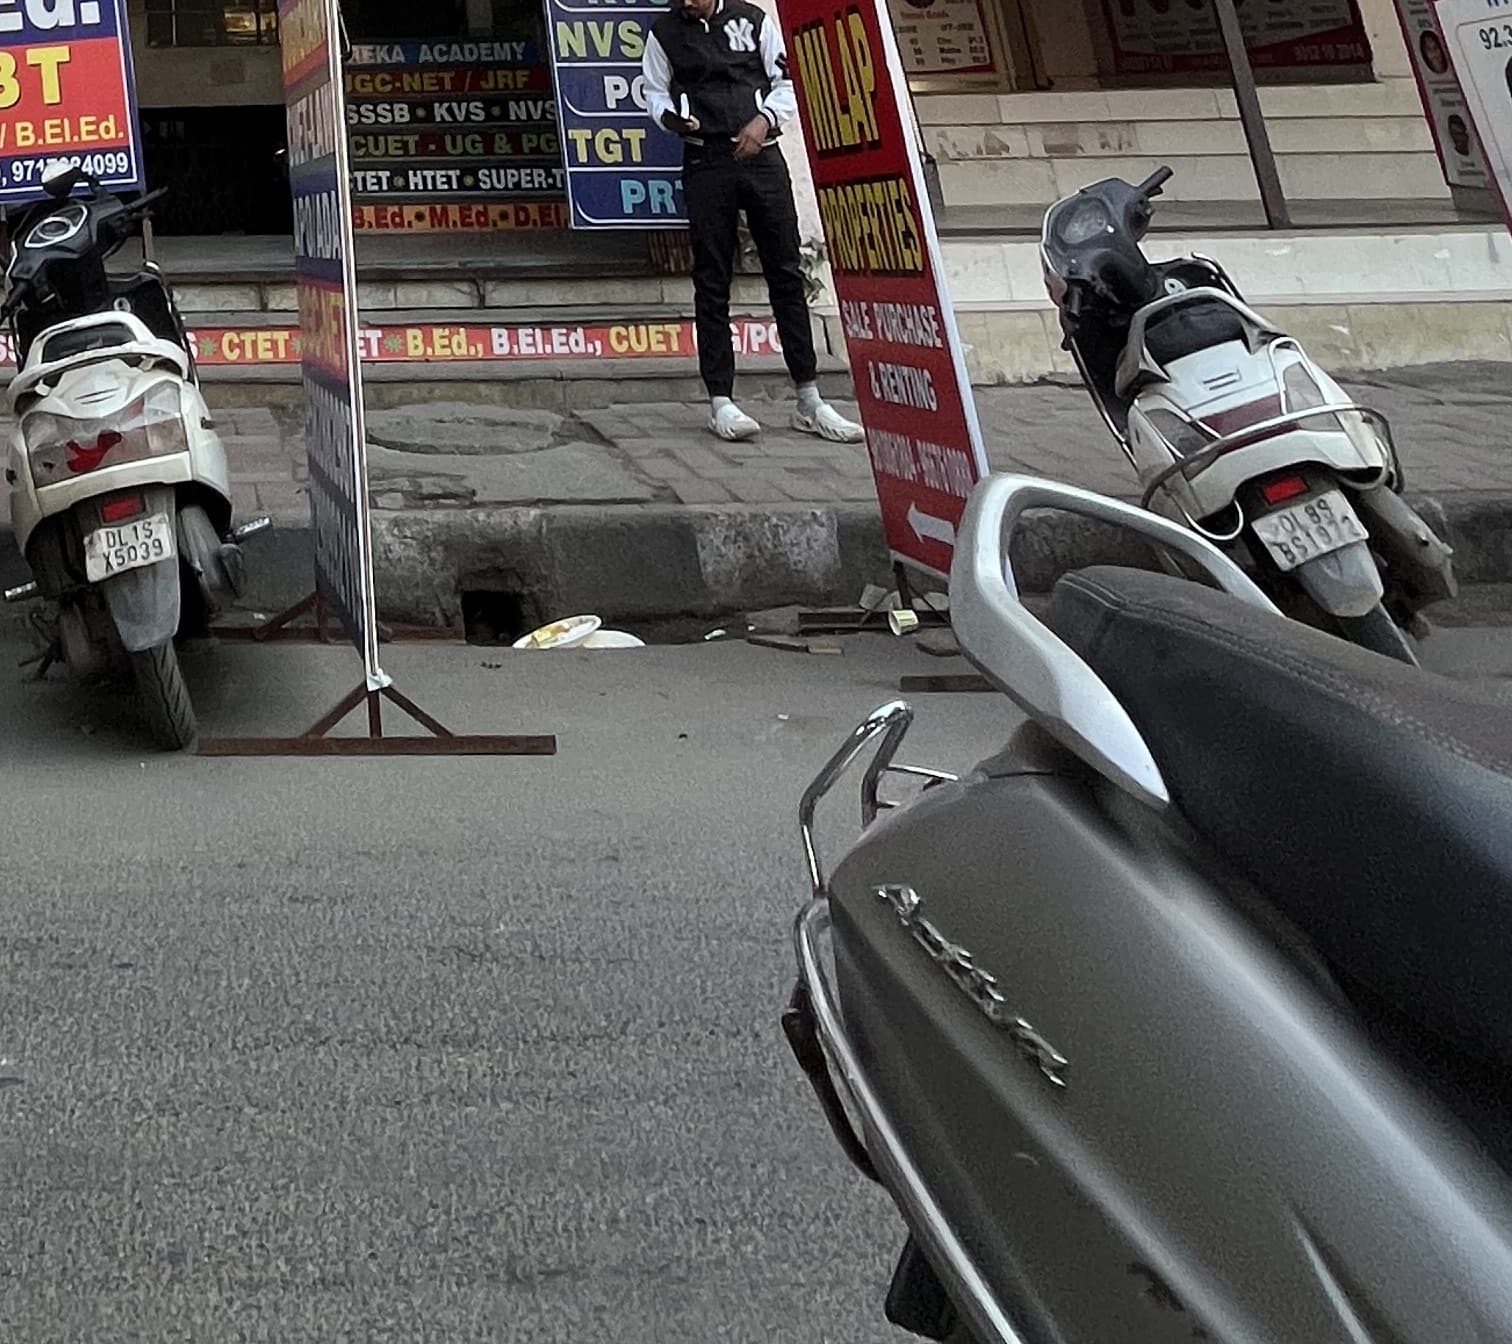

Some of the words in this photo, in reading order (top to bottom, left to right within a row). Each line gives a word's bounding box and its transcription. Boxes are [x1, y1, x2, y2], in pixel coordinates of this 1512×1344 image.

[555, 19, 645, 60] NVS
[419, 42, 526, 62] ACADEMY
[479, 69, 531, 90] JRF
[433, 102, 486, 122] KVS
[352, 135, 420, 157] CUET
[444, 133, 484, 155] UG
[521, 134, 560, 155] PG
[569, 127, 647, 163] TGT
[408, 169, 461, 191] HTET
[875, 302, 943, 350] PURCHASE
[221, 332, 289, 360] CTET
[608, 324, 682, 355] CUET
[106, 530, 128, 548] DL
[103, 538, 163, 573] X5039
